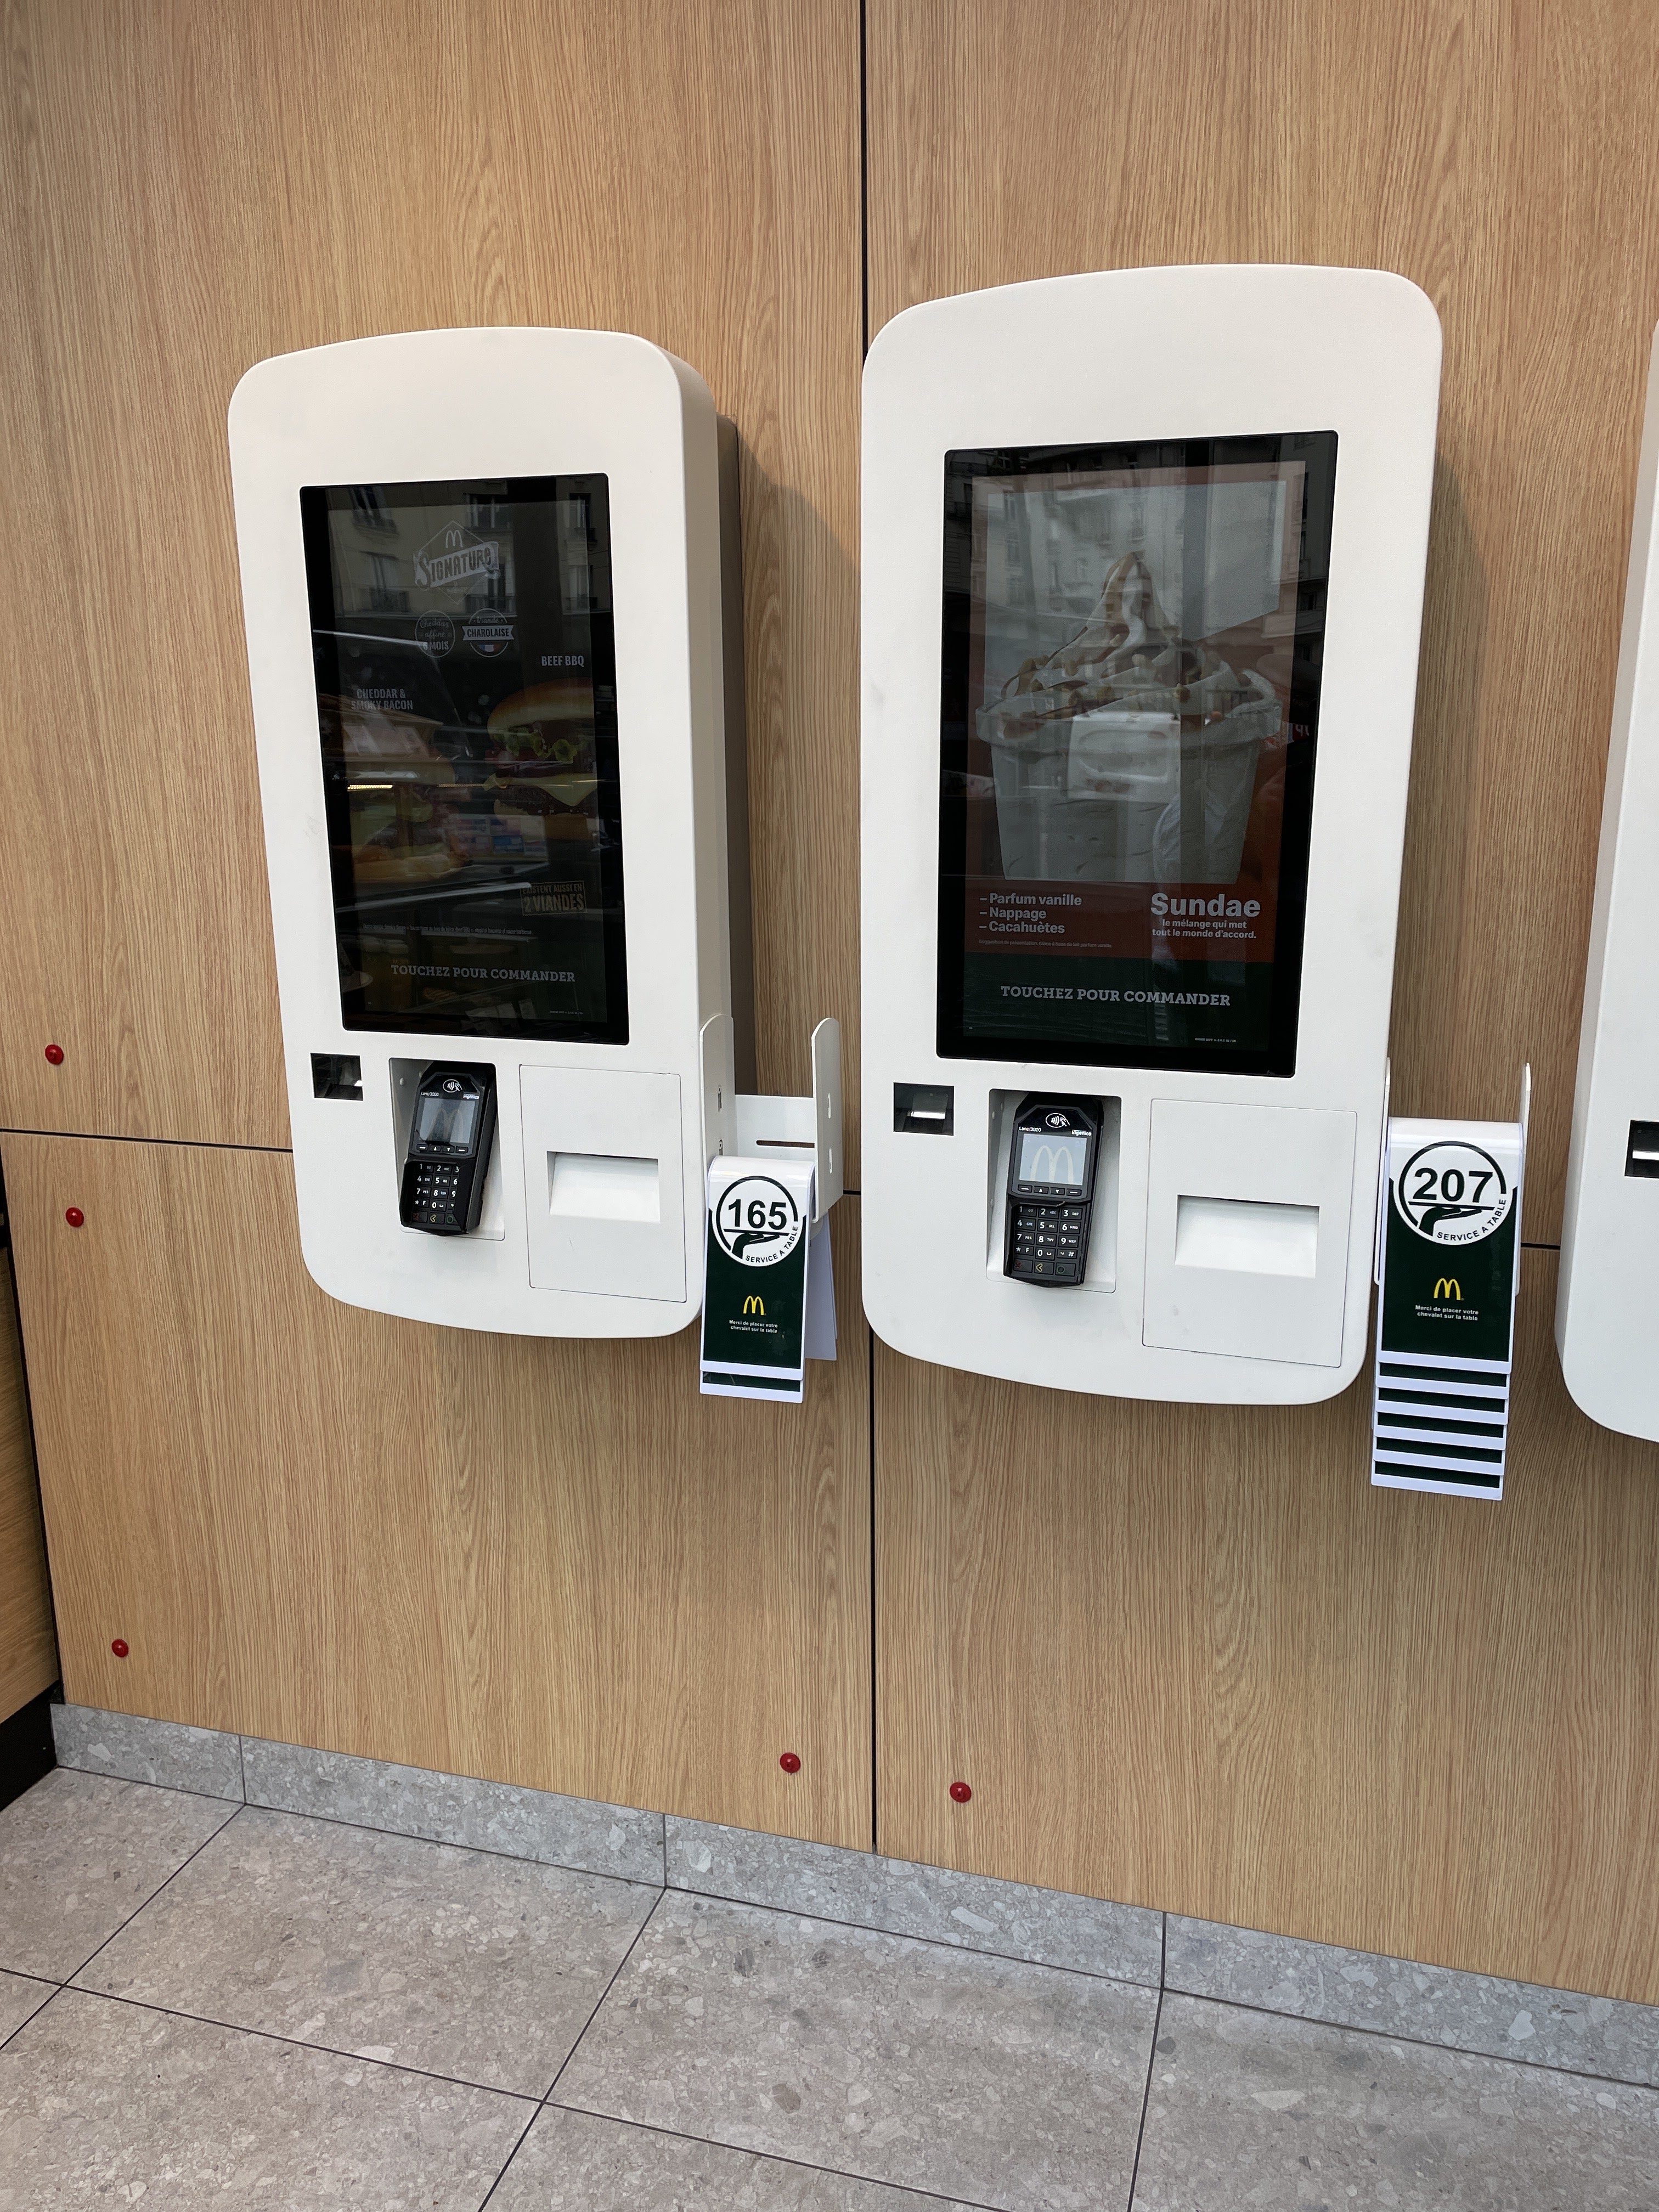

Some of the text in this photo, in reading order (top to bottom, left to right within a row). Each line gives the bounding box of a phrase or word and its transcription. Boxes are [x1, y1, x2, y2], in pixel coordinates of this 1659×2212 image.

[467, 628, 510, 637] CHAROLAISE
[429, 641, 449, 651] MOIS
[541, 656, 585, 668] BEEF BBQ
[357, 688, 406, 699] CHEDDAR &
[351, 699, 414, 710] SMOKY BACON
[523, 893, 585, 912] 2 VIANDES
[989, 893, 1036, 905] Parfum
[1039, 893, 1082, 906] vanille
[1150, 892, 1261, 917] Sundae
[989, 906, 1047, 922] Nappage
[989, 921, 1065, 934] Cacahuètes
[1163, 918, 1170, 927] le
[1172, 918, 1211, 929] mélange
[1212, 920, 1227, 929] qui
[1152, 928, 1171, 936] tout
[1182, 929, 1214, 938] monde
[1215, 930, 1256, 939] d'accord.
[391, 964, 575, 983] TOUCHEZ POUR COMMANDER
[1000, 985, 1231, 1007] TOUCHEZ POUR COMMANDER
[1413, 1167, 1493, 1203] 207
[728, 1199, 787, 1230] 165
[1437, 1230, 1480, 1241] SERVICE
[1487, 1199, 1506, 1226] TABLE
[745, 1253, 778, 1263] SERVICE
[783, 1226, 798, 1250] TABLE
